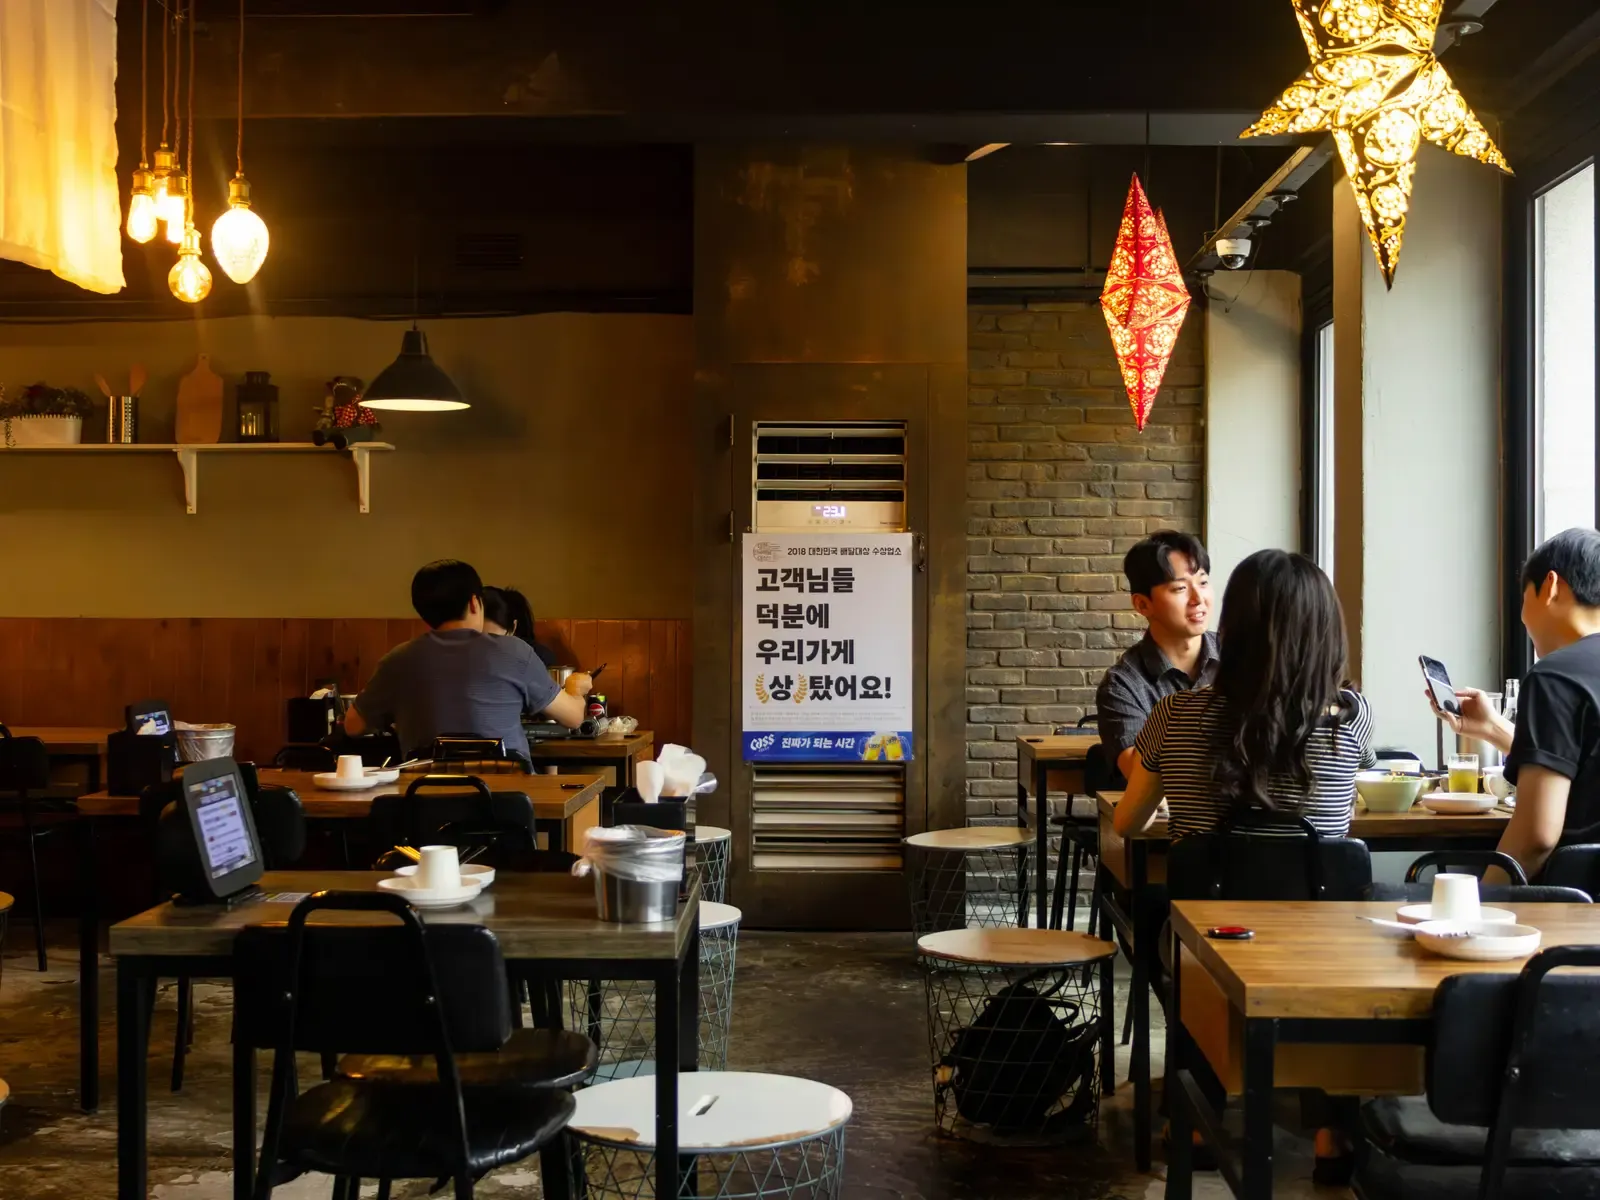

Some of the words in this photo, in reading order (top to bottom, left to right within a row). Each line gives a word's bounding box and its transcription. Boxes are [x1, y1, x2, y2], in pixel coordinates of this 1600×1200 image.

[787, 547, 806, 556] 2018
[808, 547, 838, 556] 대한민국
[840, 547, 870, 556] 배달대상
[872, 547, 902, 556] 수상업소
[755, 567, 855, 593] 고객님들
[756, 603, 830, 629] 덕분에
[755, 639, 855, 665] 우리가게
[768, 674, 794, 701] 상
[808, 674, 892, 701] 탔어요!
[812, 737, 833, 749] 되는
[835, 737, 855, 749] 시간
